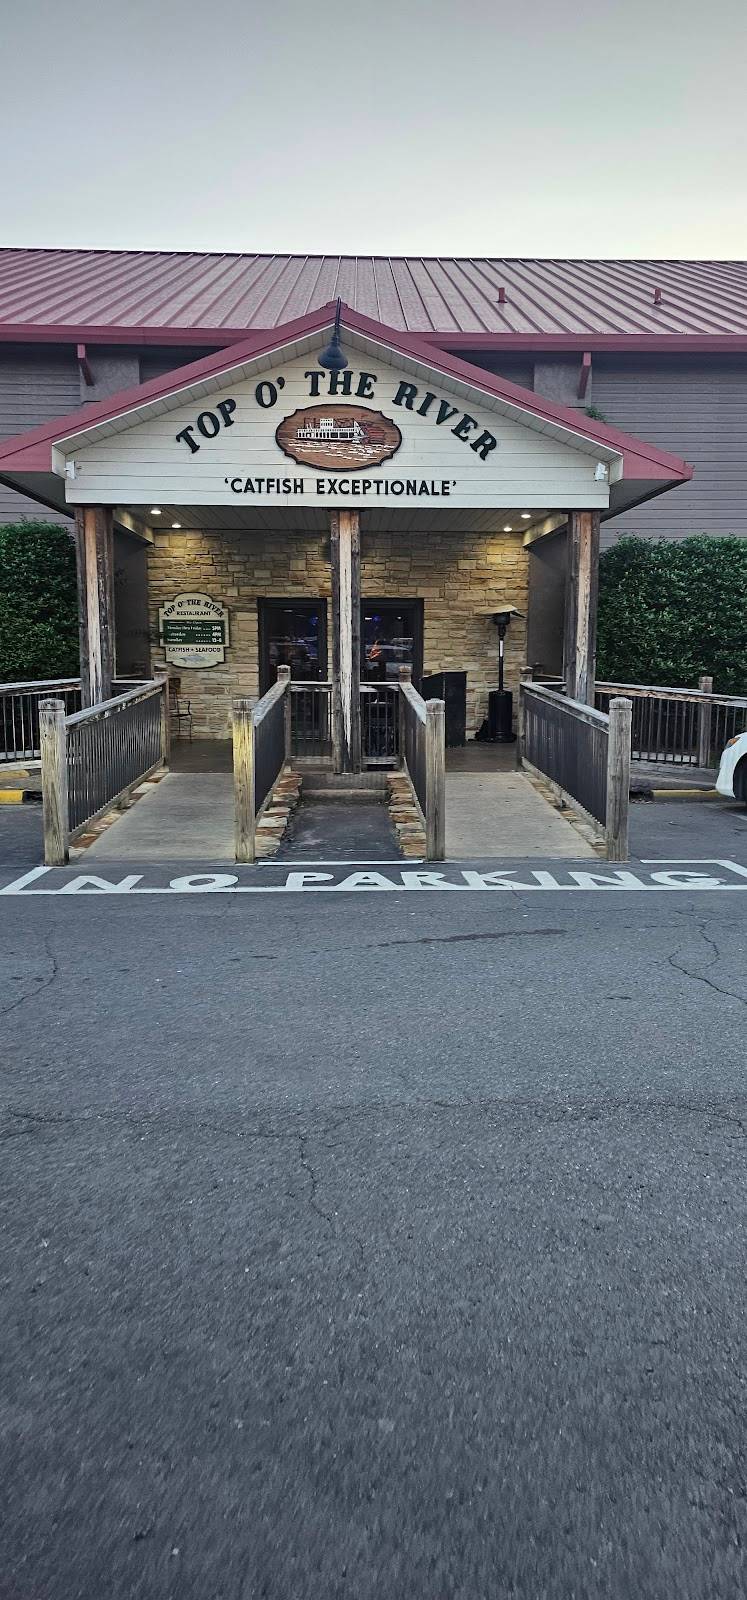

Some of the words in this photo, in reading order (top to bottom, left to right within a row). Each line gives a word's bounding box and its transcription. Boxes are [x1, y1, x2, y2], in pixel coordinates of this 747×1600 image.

[175, 399, 237, 454] TOP
[255, 376, 286, 408] O'
[305, 370, 377, 399] THE
[392, 381, 497, 461] RIVER
[163, 605, 176, 617] TOP
[203, 601, 224, 618] RIVER
[60, 873, 240, 891] NO
[286, 870, 728, 889] PARKING
